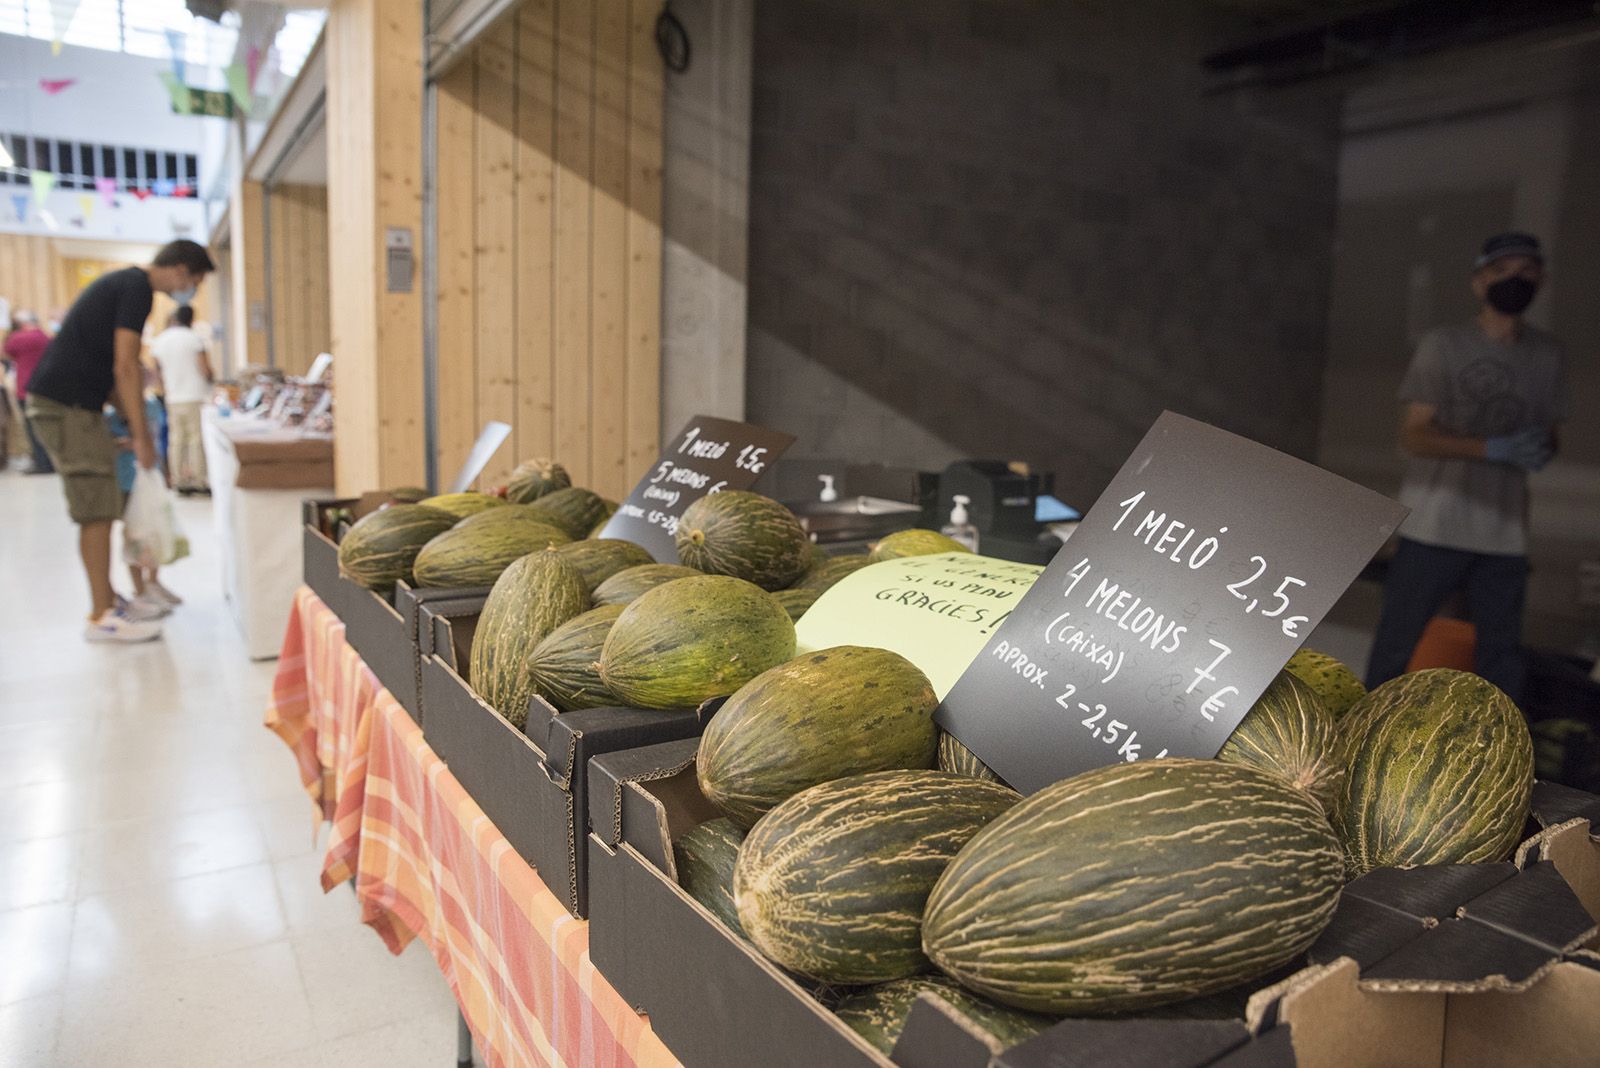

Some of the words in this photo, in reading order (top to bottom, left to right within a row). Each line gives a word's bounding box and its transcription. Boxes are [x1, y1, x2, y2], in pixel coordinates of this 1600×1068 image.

[678, 427, 700, 454] 1
[650, 460, 674, 484] 5
[1112, 491, 1146, 531] 1
[1133, 510, 1229, 569] MELÓ
[933, 578, 955, 588] US
[1065, 557, 1092, 598] 4
[1085, 577, 1188, 654] MELONS
